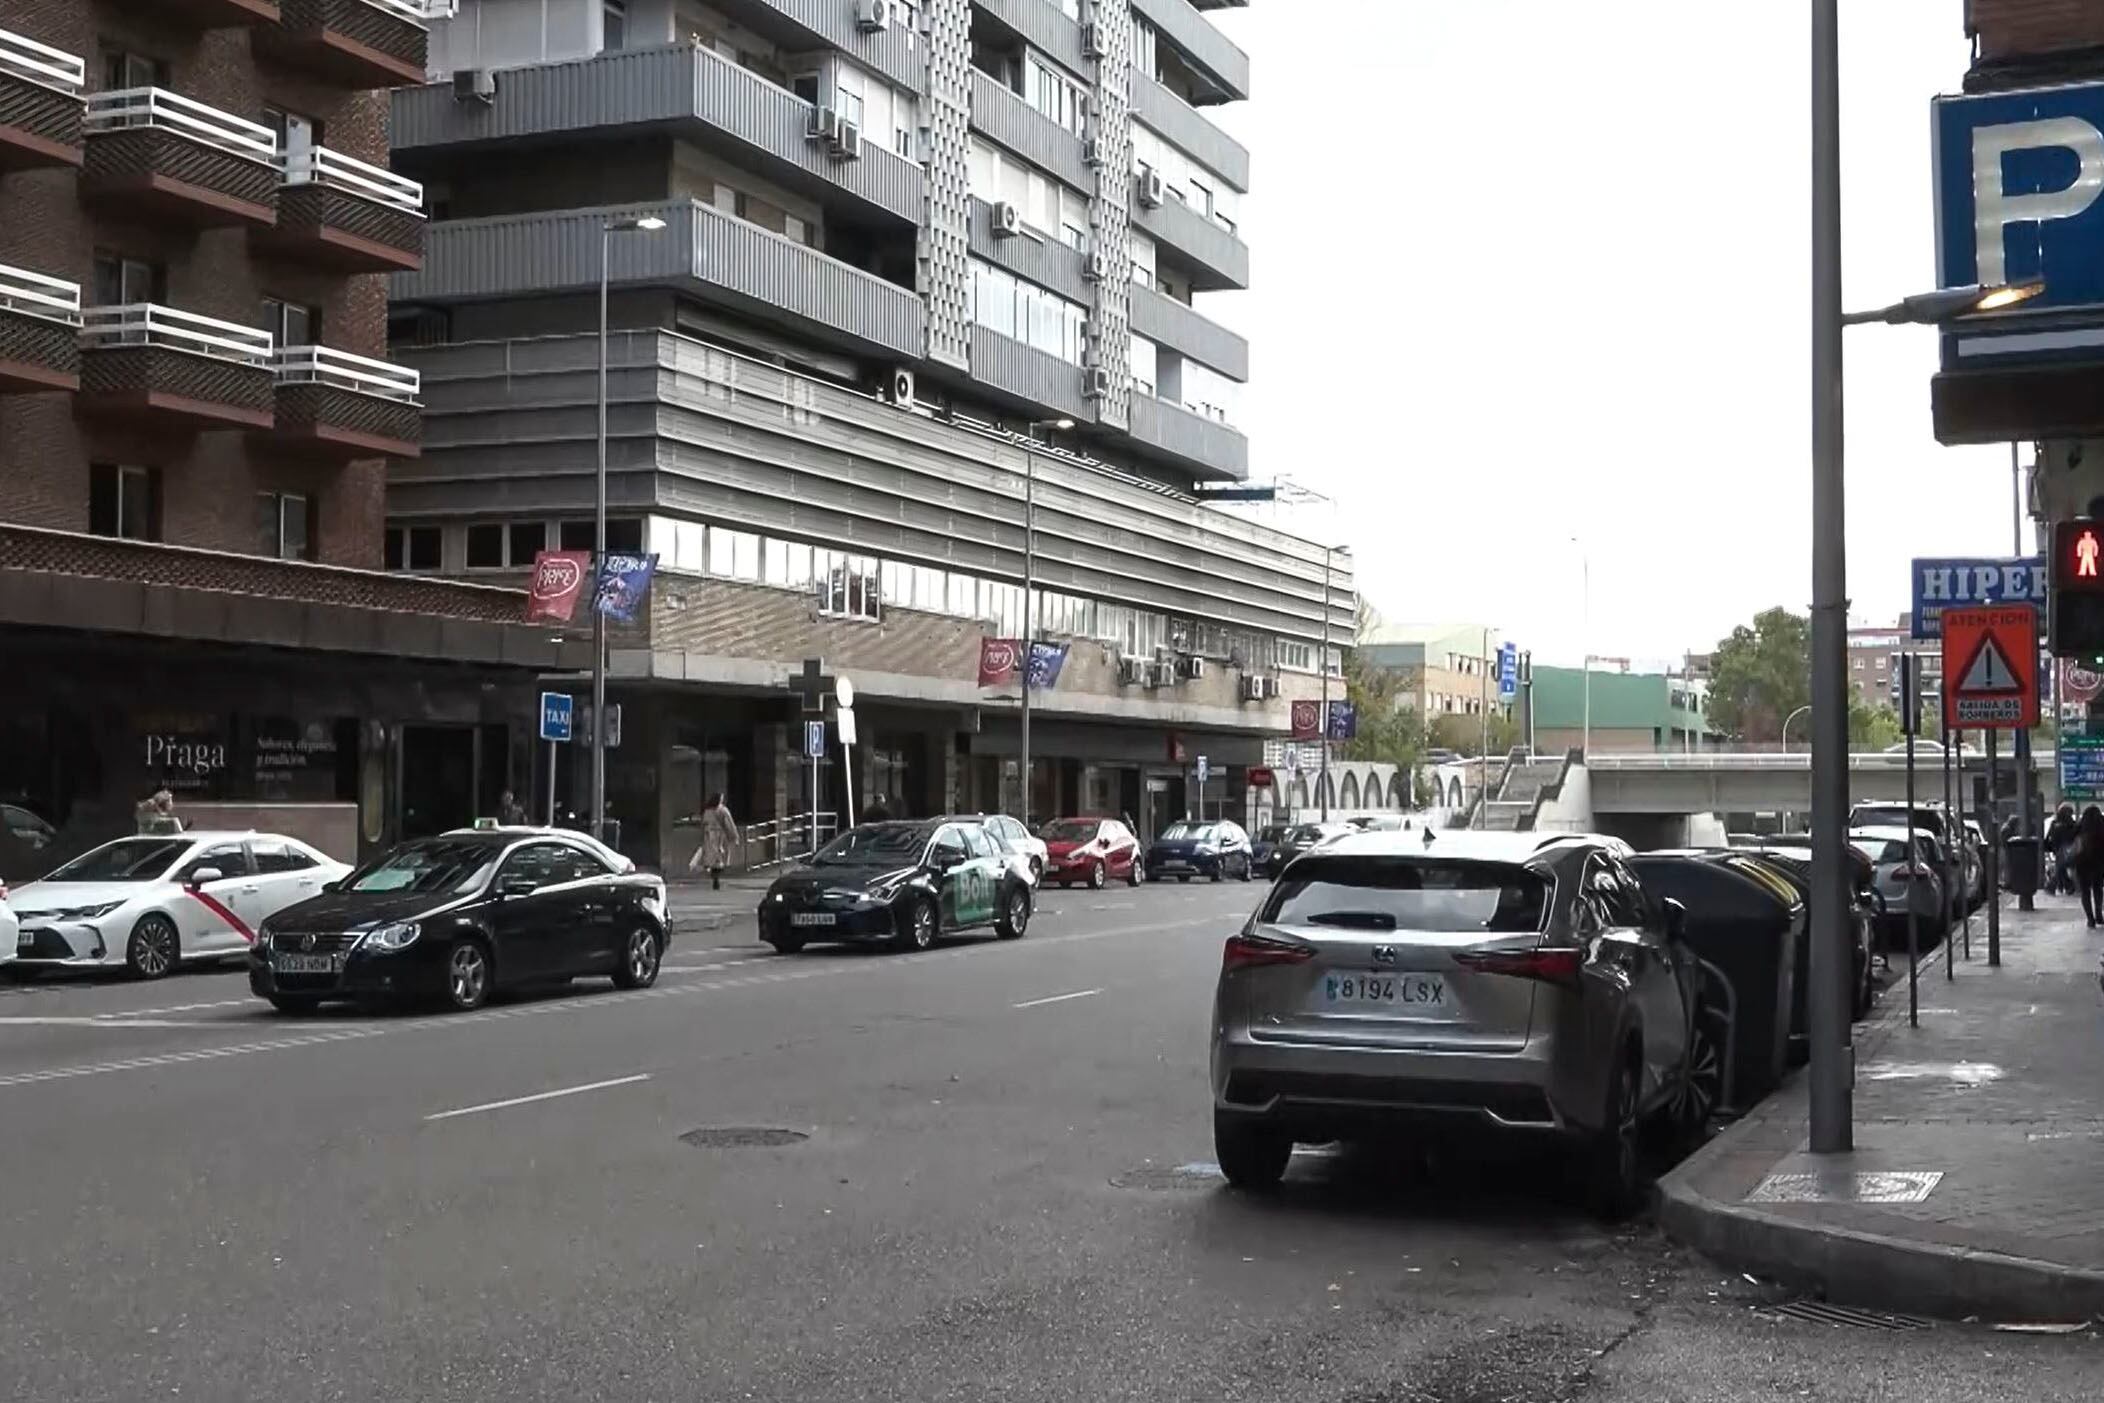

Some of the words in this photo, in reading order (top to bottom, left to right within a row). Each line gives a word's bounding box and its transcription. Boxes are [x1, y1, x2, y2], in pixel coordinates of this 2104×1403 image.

[1972, 116, 2104, 287] P
[1959, 700, 1999, 710] SALIDA
[546, 710, 570, 725] TAXI
[1341, 978, 1394, 1001] 8194
[1402, 977, 1443, 1003] LSX
